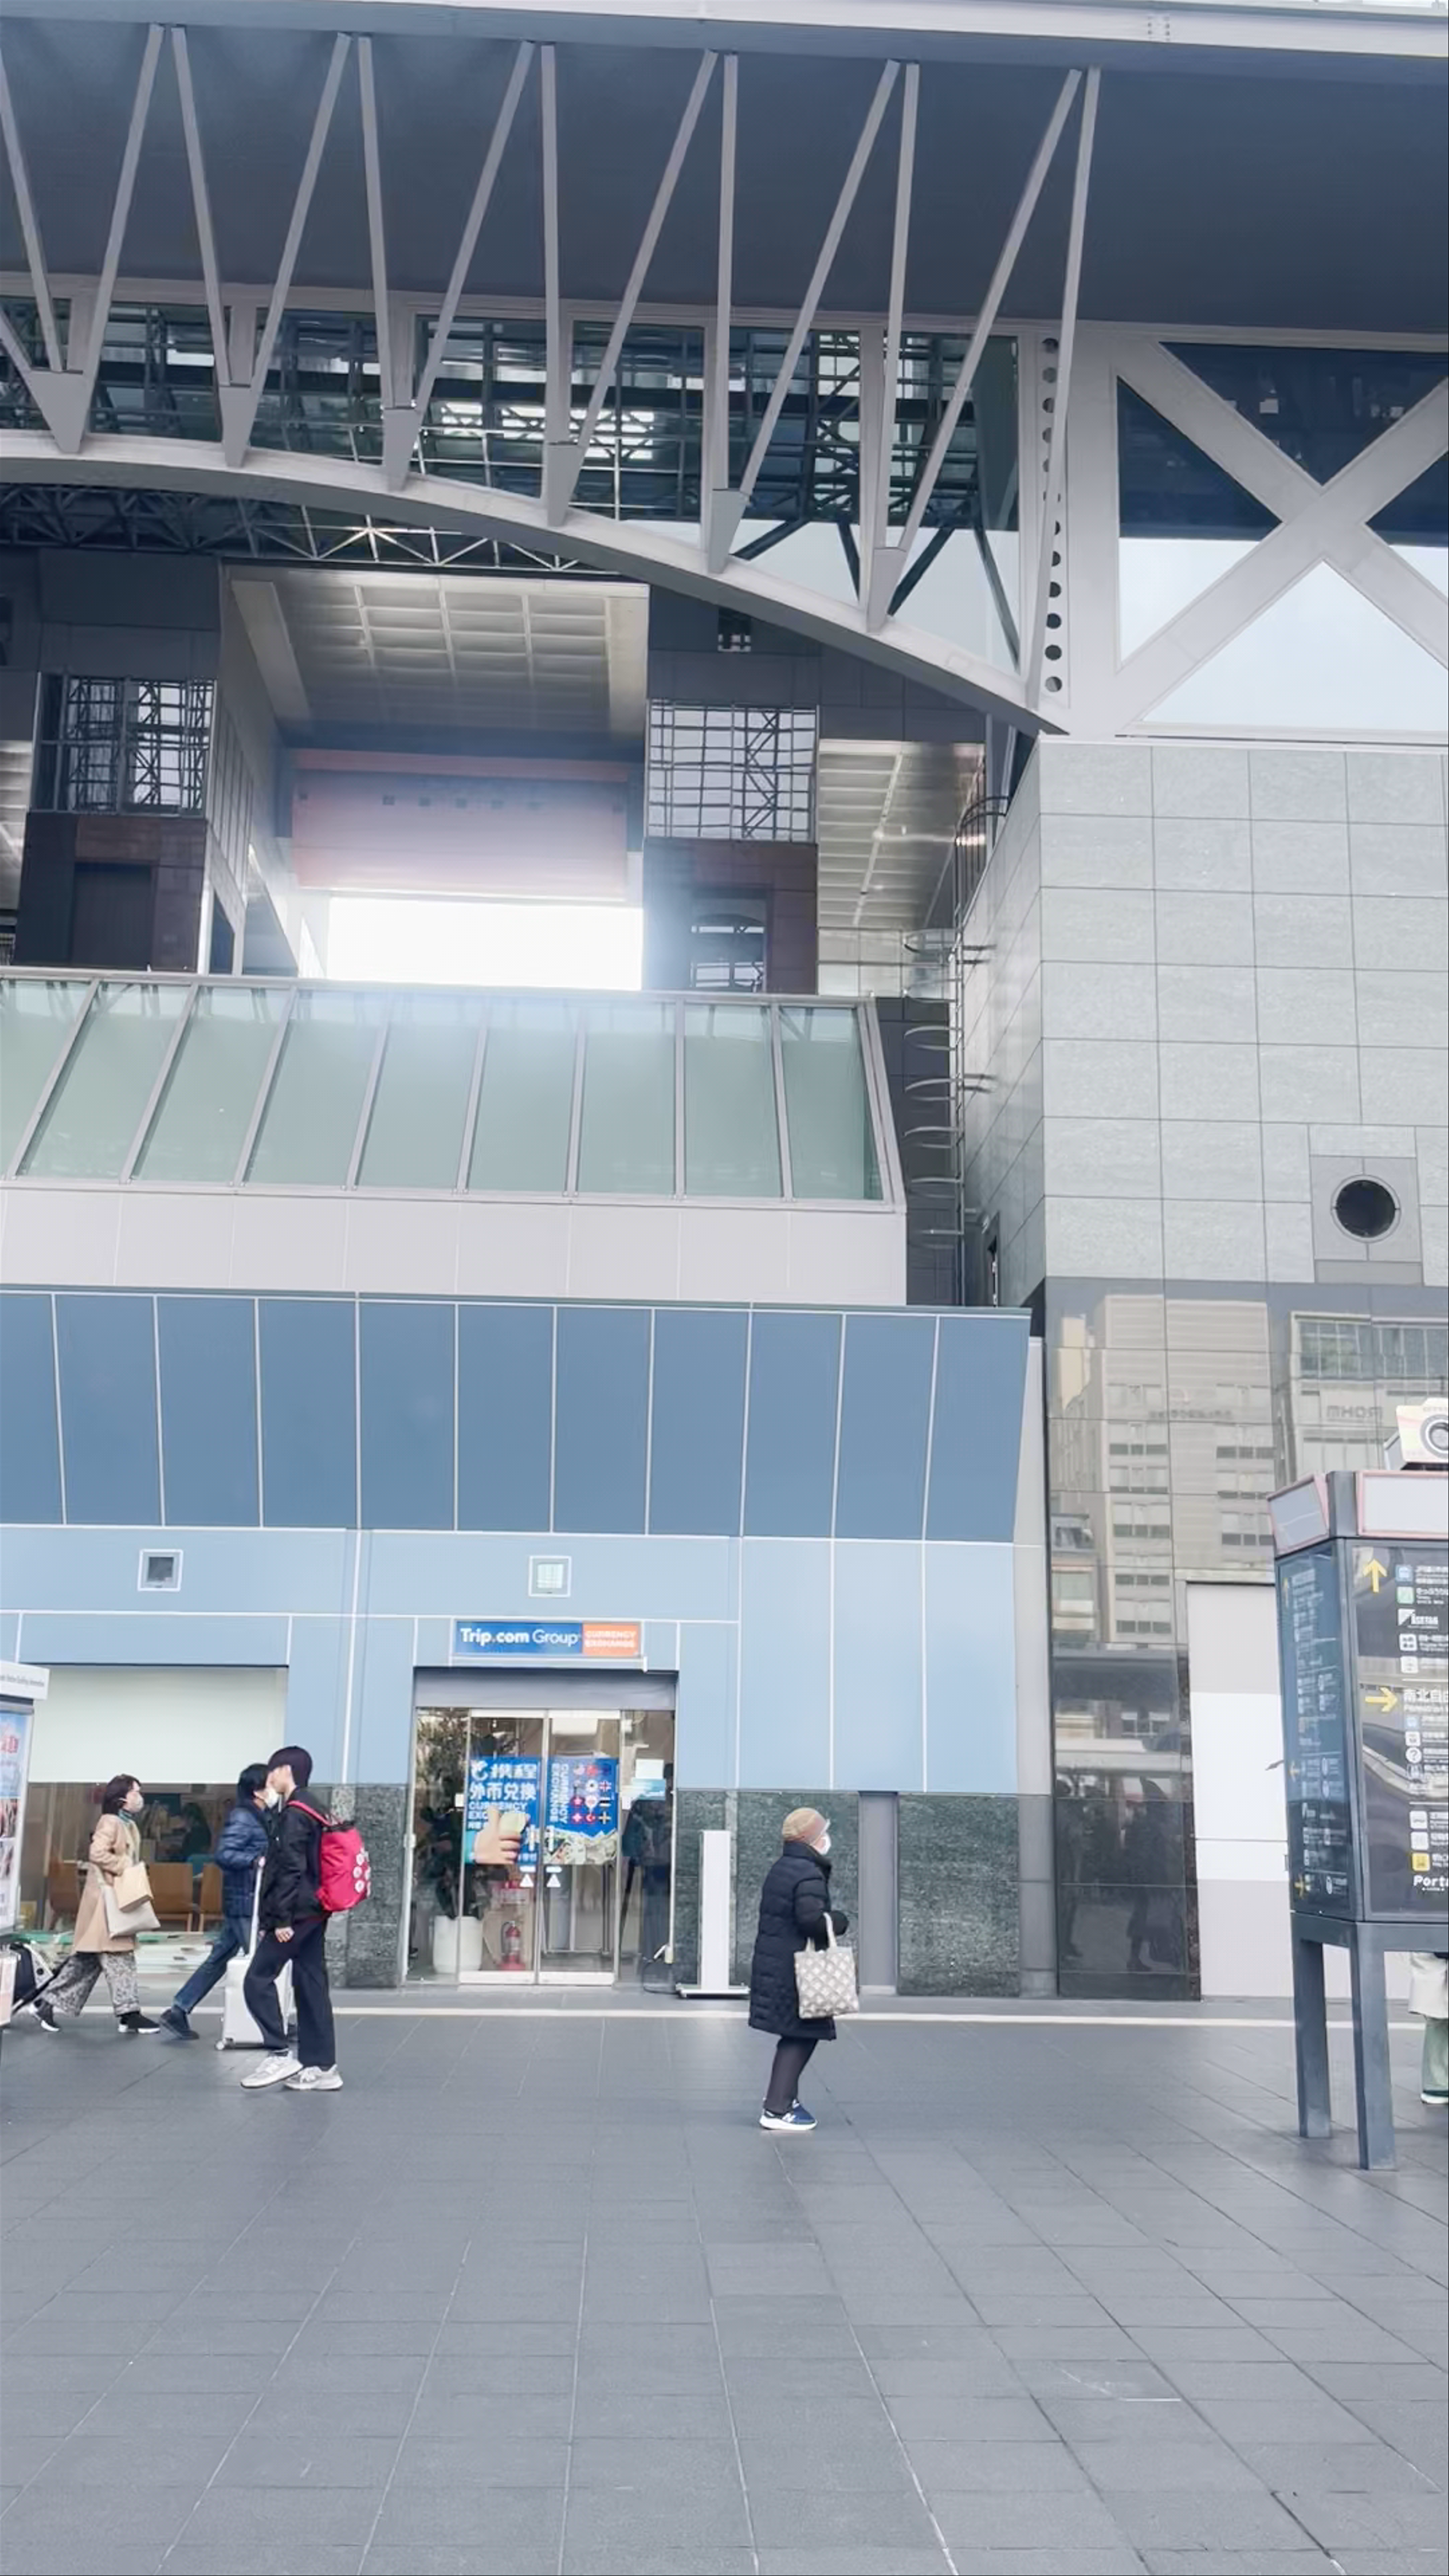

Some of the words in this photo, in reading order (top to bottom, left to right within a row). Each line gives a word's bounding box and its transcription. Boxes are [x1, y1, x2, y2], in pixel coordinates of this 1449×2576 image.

[460, 1628, 529, 1646] Trip.com
[532, 1629, 579, 1647] Group
[1413, 1875, 1448, 1887] Port
